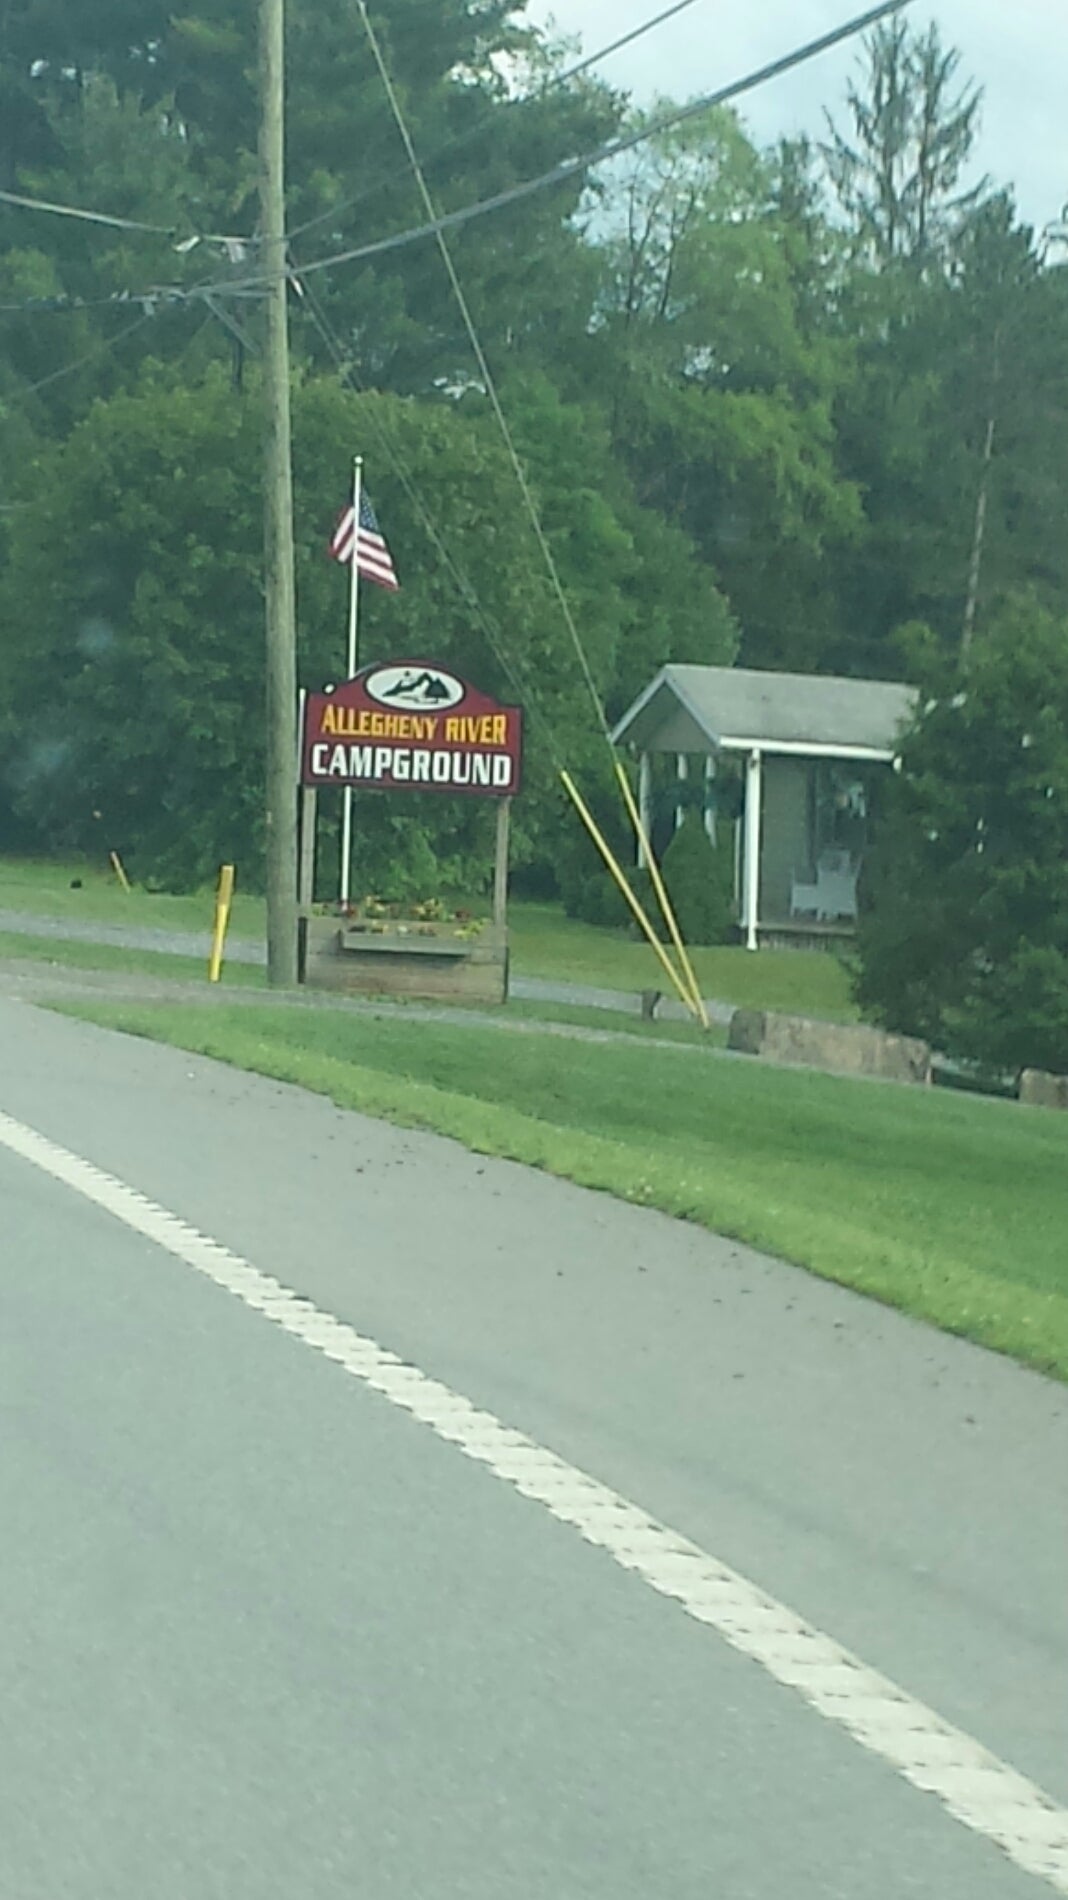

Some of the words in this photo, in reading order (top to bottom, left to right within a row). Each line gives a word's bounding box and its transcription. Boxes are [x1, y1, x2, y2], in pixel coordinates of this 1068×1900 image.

[321, 704, 438, 741] ALLEGHENY
[445, 714, 507, 745] RIVER
[311, 743, 512, 786] CAMPGROUND
